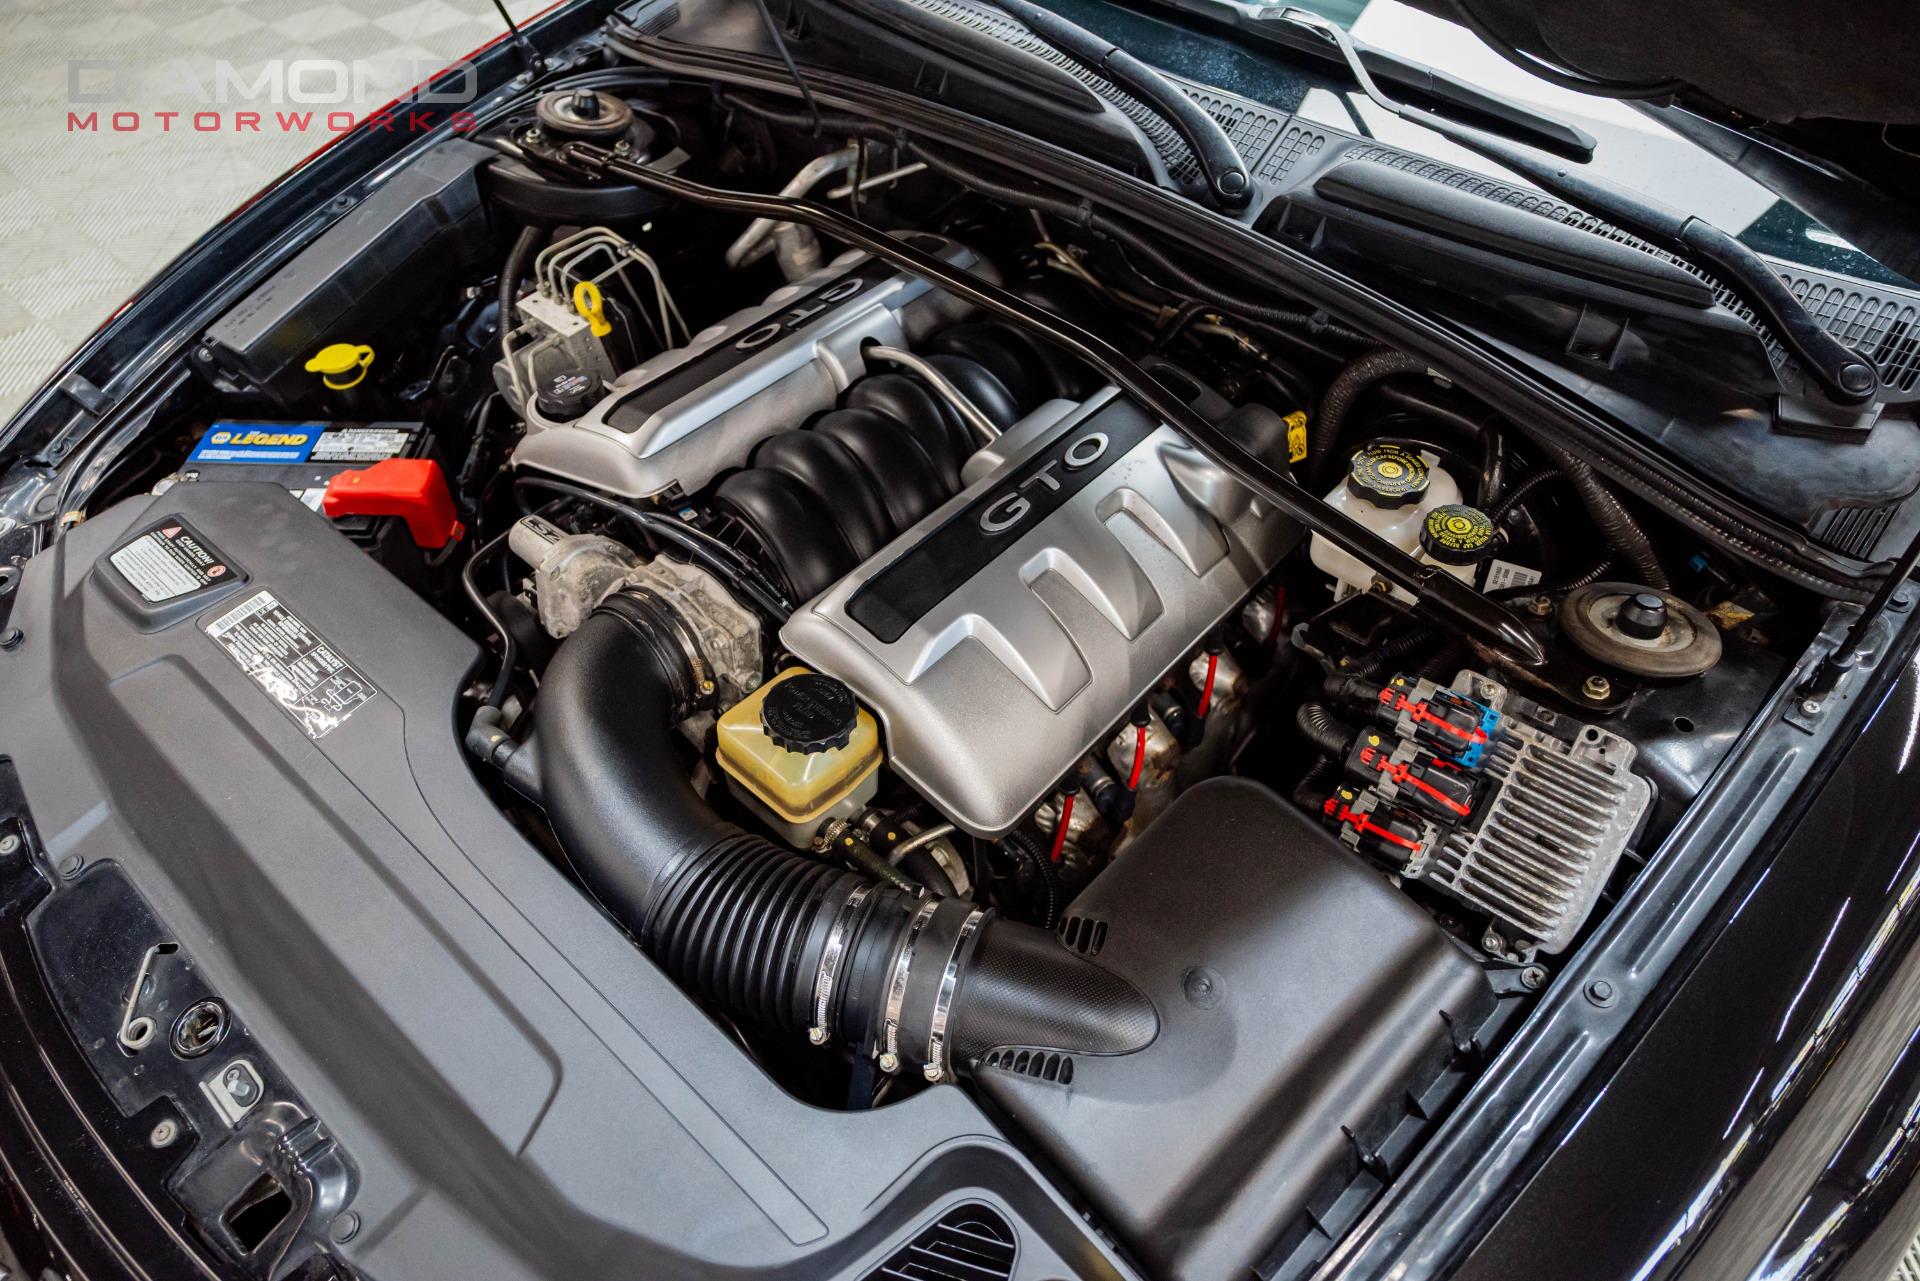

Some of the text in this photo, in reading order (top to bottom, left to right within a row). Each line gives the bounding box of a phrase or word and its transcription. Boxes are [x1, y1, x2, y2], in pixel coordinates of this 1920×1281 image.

[735, 278, 864, 350] GTO
[230, 432, 308, 446] LEGEND
[979, 432, 1109, 532] GTO
[180, 535, 214, 564] CAUTION!
